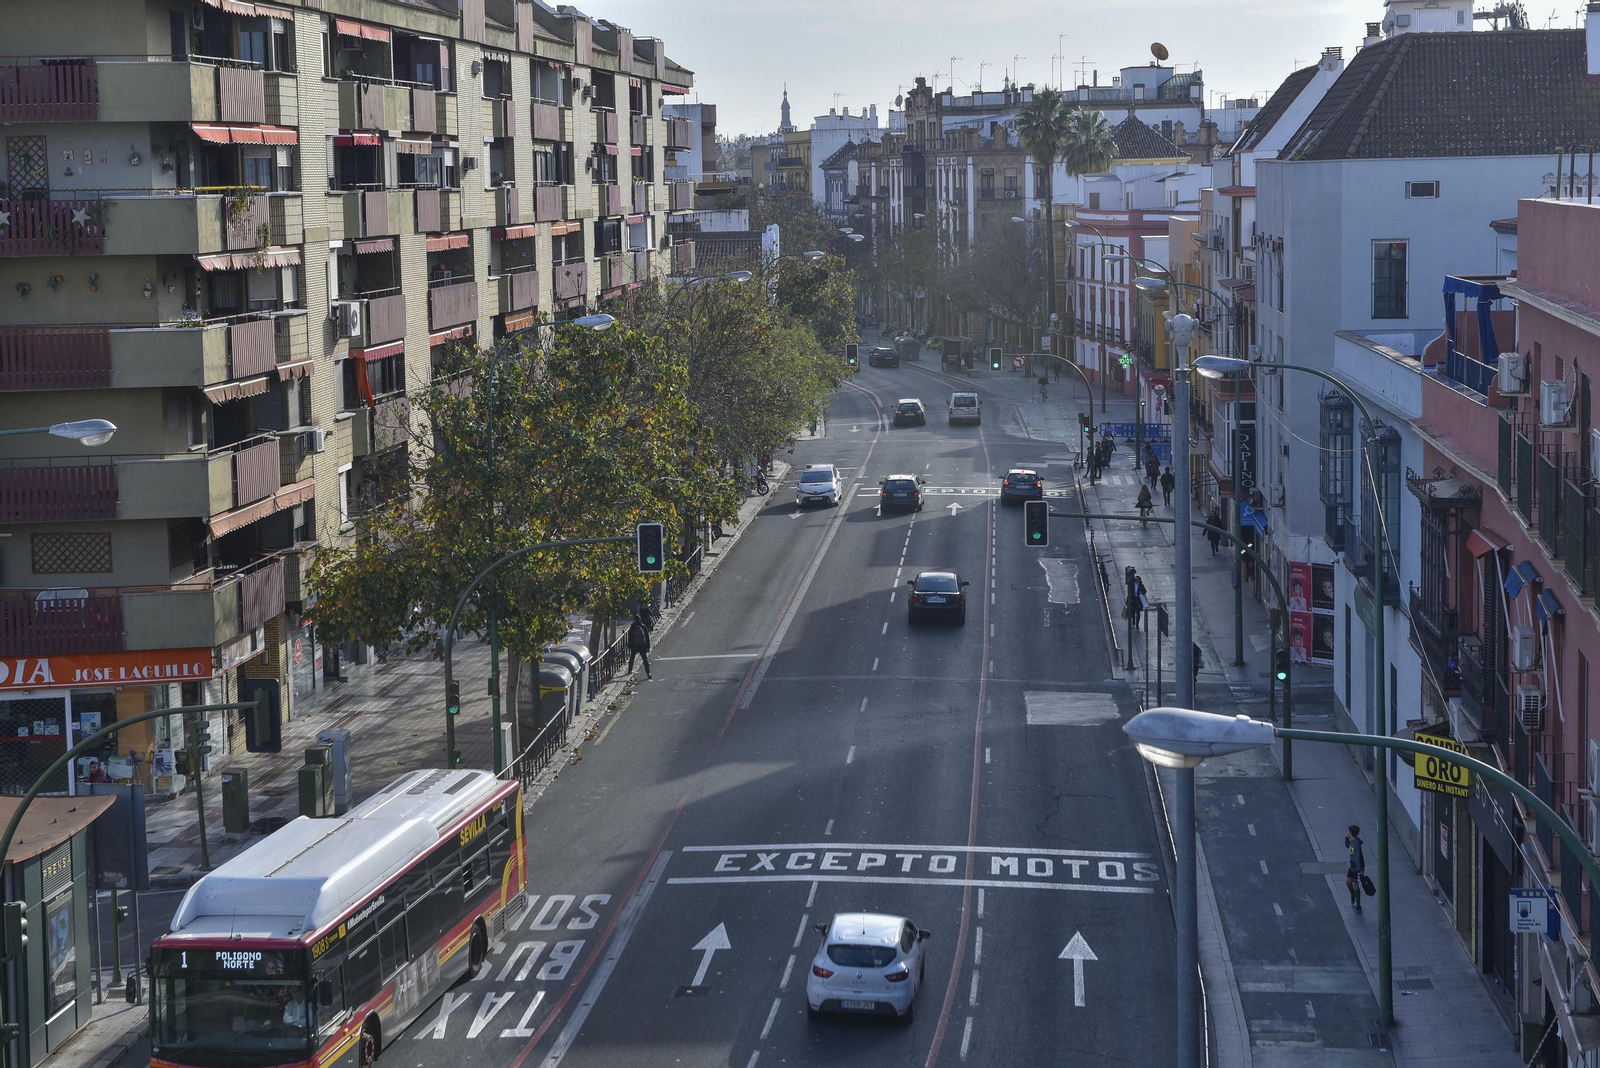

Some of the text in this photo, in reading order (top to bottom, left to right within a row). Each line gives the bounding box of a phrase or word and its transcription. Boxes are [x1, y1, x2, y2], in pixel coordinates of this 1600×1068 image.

[72, 667, 114, 682] JOSE
[119, 662, 205, 680] LAGUILLO
[1426, 756, 1461, 783] ORO
[1416, 778, 1436, 791] DINERO
[1437, 783, 1445, 793] AL
[460, 813, 487, 847] SEVILLA
[42, 853, 71, 881] PRENSA
[713, 851, 1160, 882] EXCEPTO MOTOS
[181, 951, 262, 969] 1 POLIGONO
[223, 960, 255, 969] NORTE
